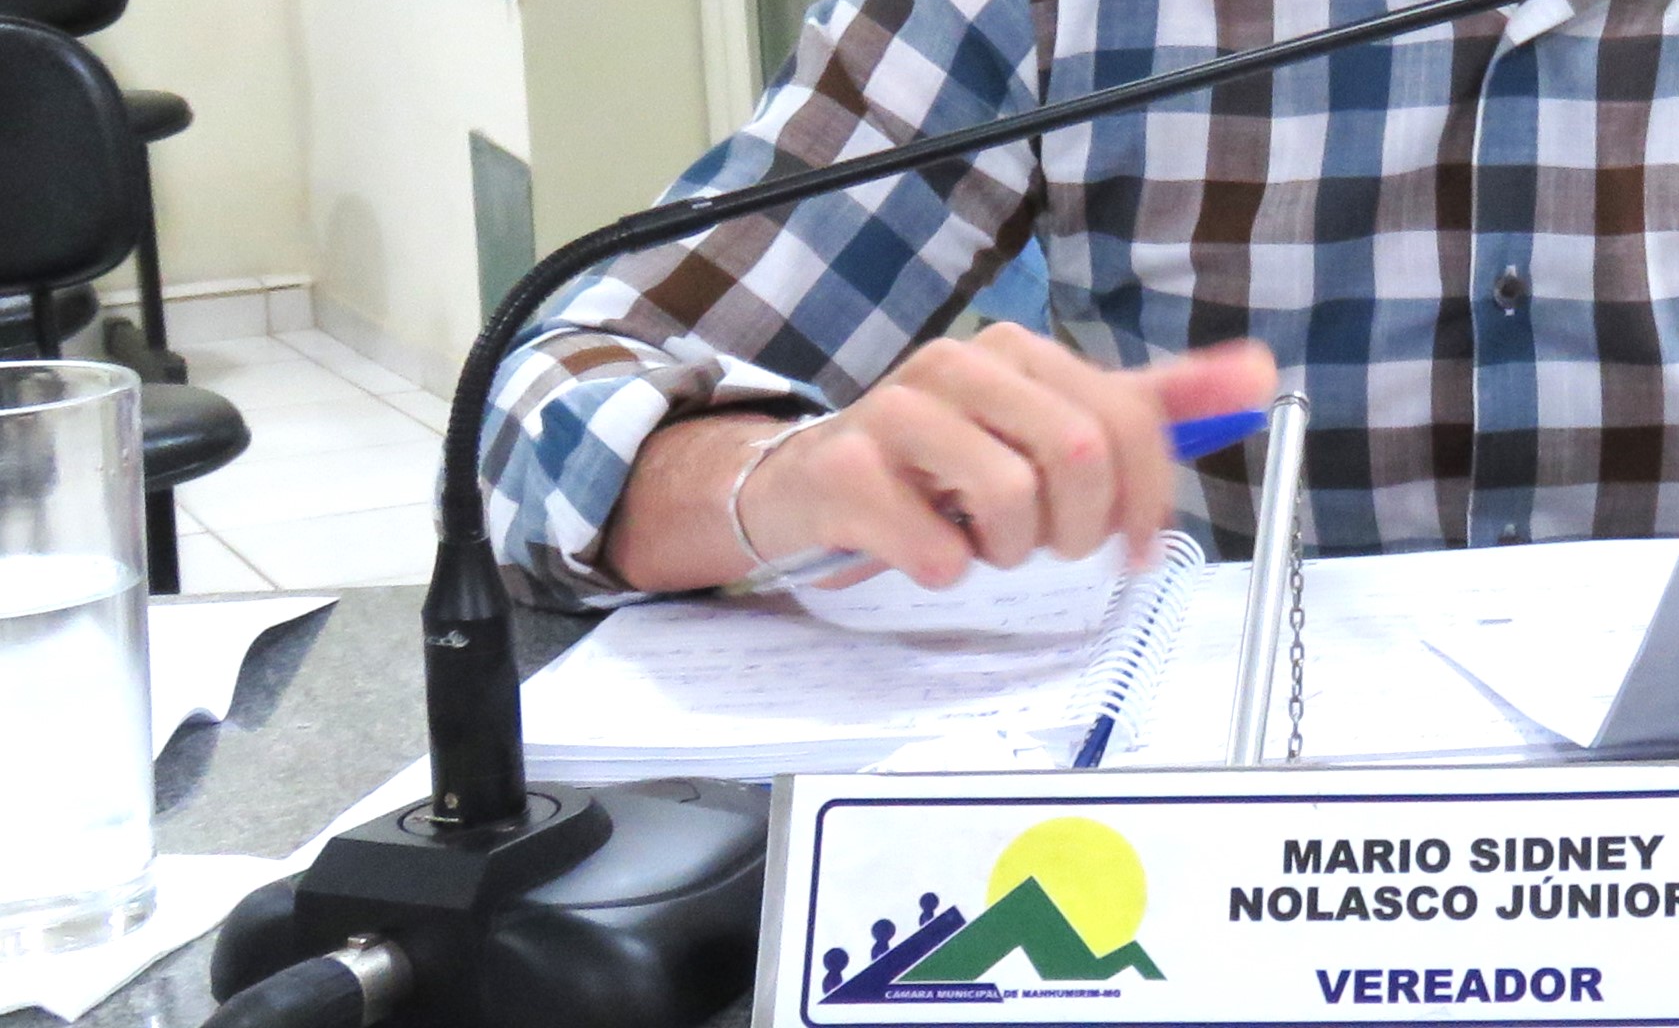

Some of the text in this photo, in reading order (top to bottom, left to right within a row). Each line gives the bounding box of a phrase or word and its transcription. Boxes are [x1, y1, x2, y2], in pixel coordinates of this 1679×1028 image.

[1282, 835, 1665, 874] MARIO SIDNEY
[1229, 885, 1478, 921] NOLASCO
[936, 989, 1000, 999] MUNICIPAL
[1003, 989, 1018, 999] DE
[1315, 967, 1604, 1003] VEREADOR
